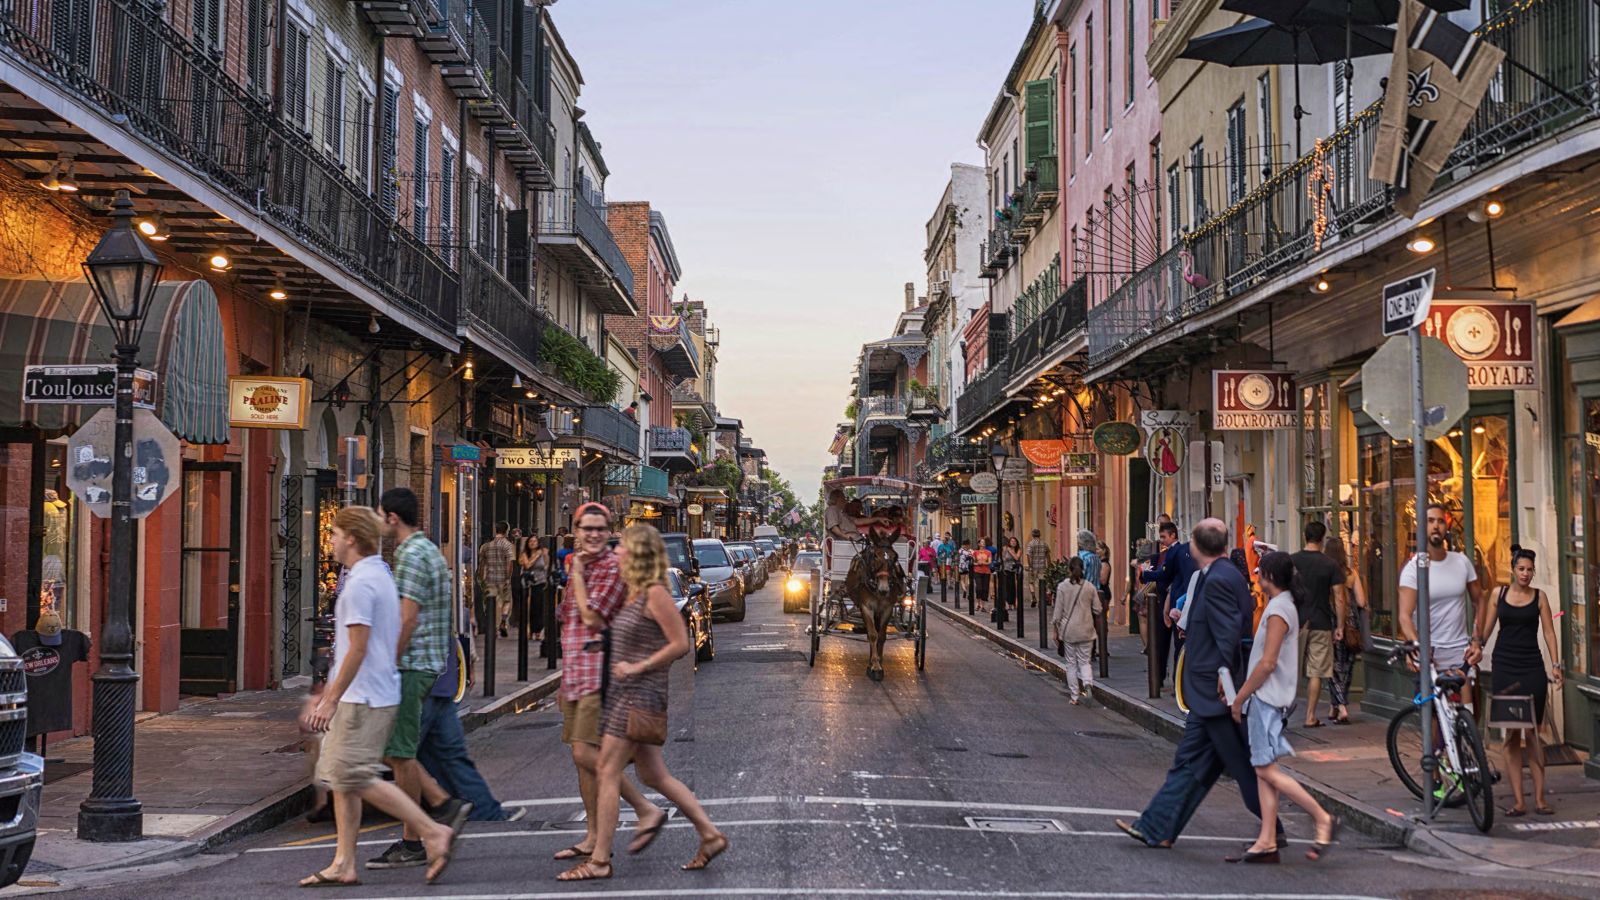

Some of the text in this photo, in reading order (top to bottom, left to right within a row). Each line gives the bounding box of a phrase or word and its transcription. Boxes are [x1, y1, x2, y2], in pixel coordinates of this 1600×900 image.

[1389, 297, 1403, 318] ONE
[1467, 366, 1535, 385] ROYALE
[27, 378, 114, 396] Toulouse
[243, 395, 288, 405] PRALINE
[1217, 413, 1249, 428] ROUX
[1250, 413, 1298, 427] ROYALE
[500, 457, 525, 465] TWO
